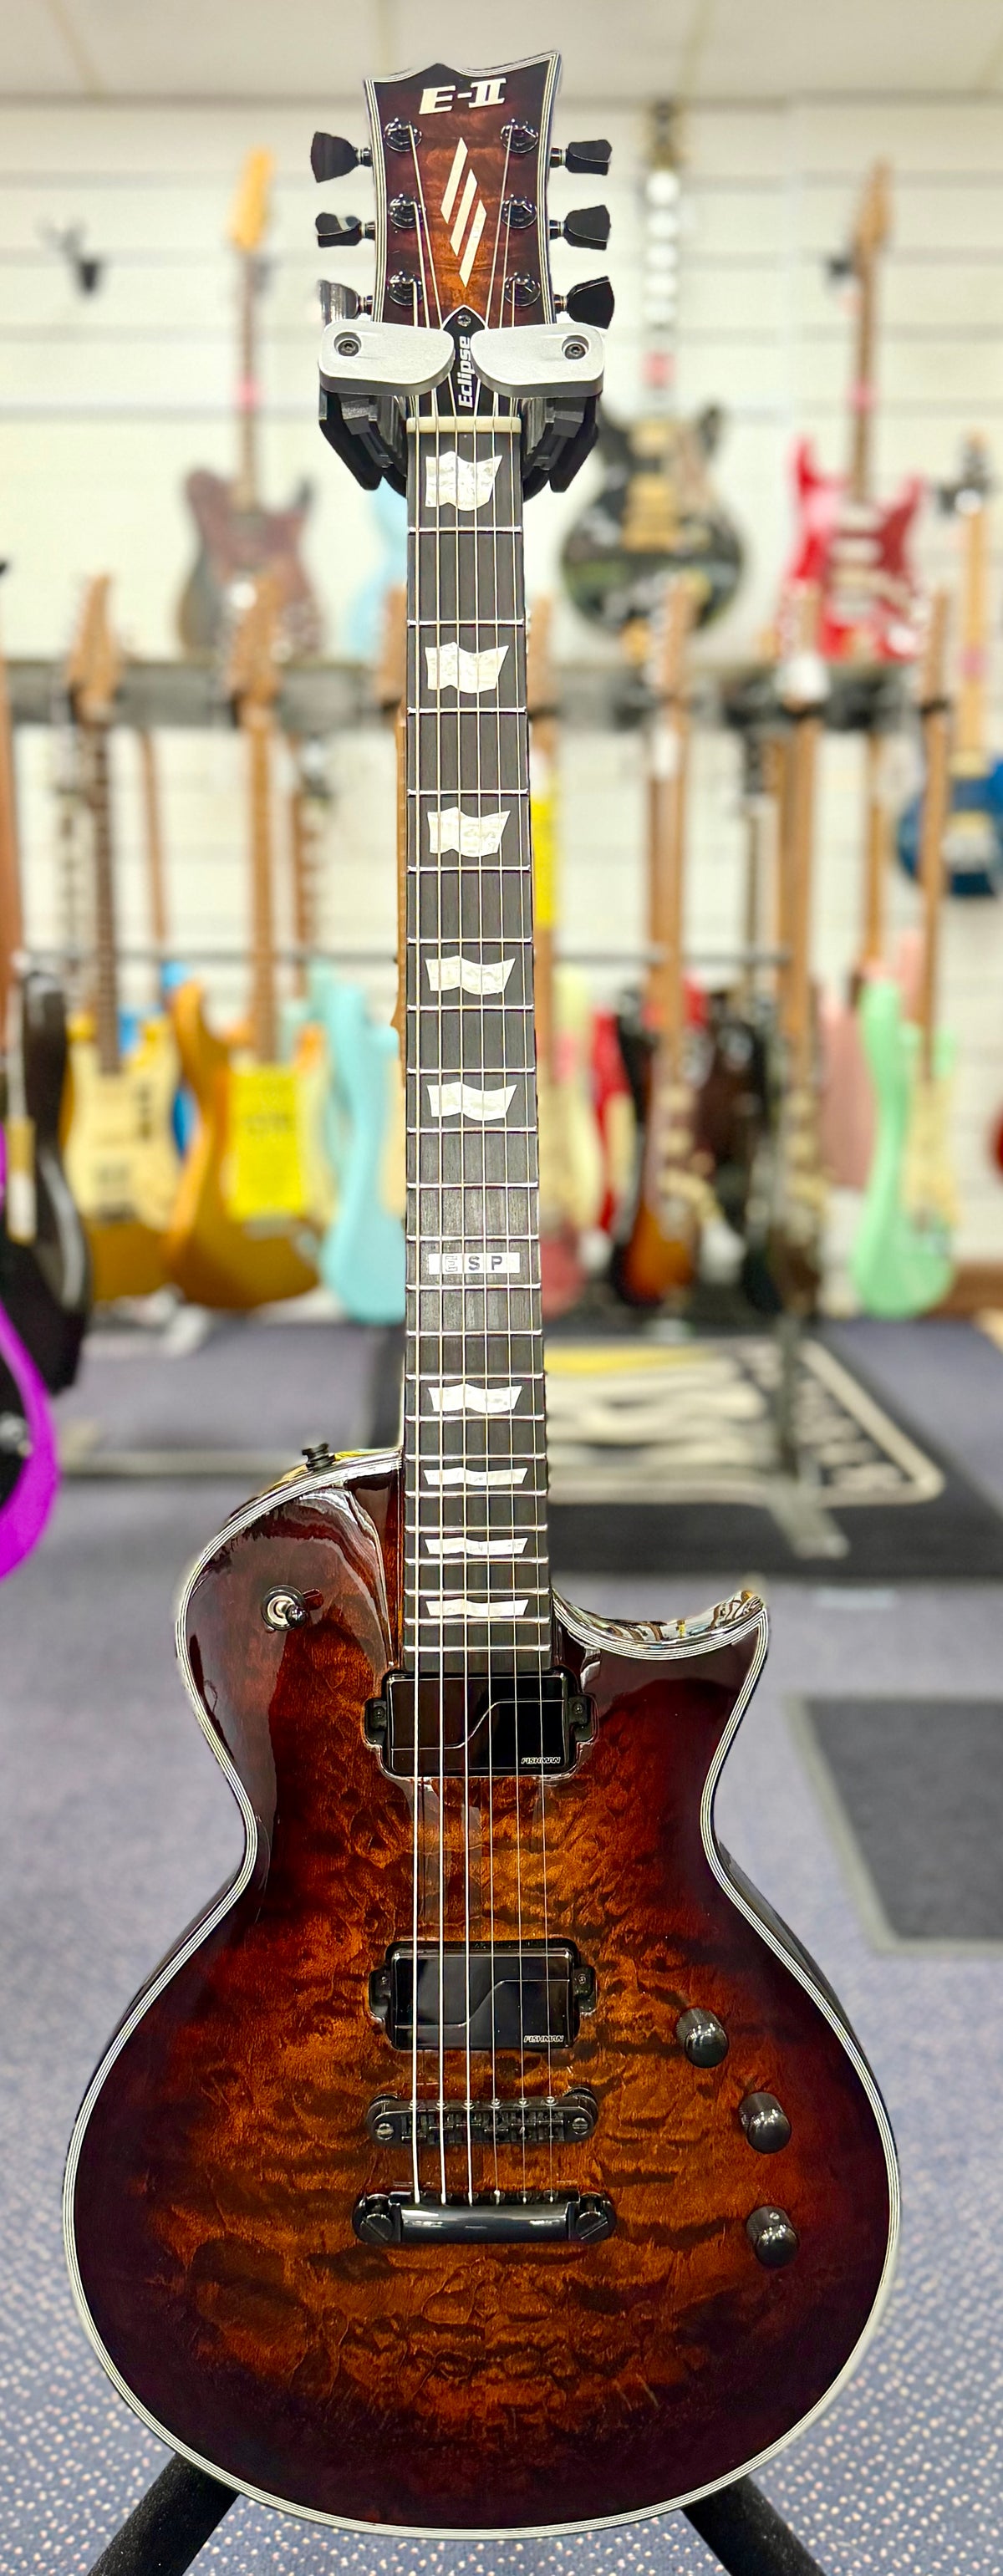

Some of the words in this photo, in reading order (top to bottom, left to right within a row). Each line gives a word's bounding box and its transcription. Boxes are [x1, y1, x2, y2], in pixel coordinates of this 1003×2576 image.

[419, 78, 507, 115] E-II
[456, 335, 476, 409] Eclipse
[445, 1255, 503, 1272] ESP
[521, 1756, 561, 1764] FISHMAN
[523, 2034, 564, 2043] FISHMAN
